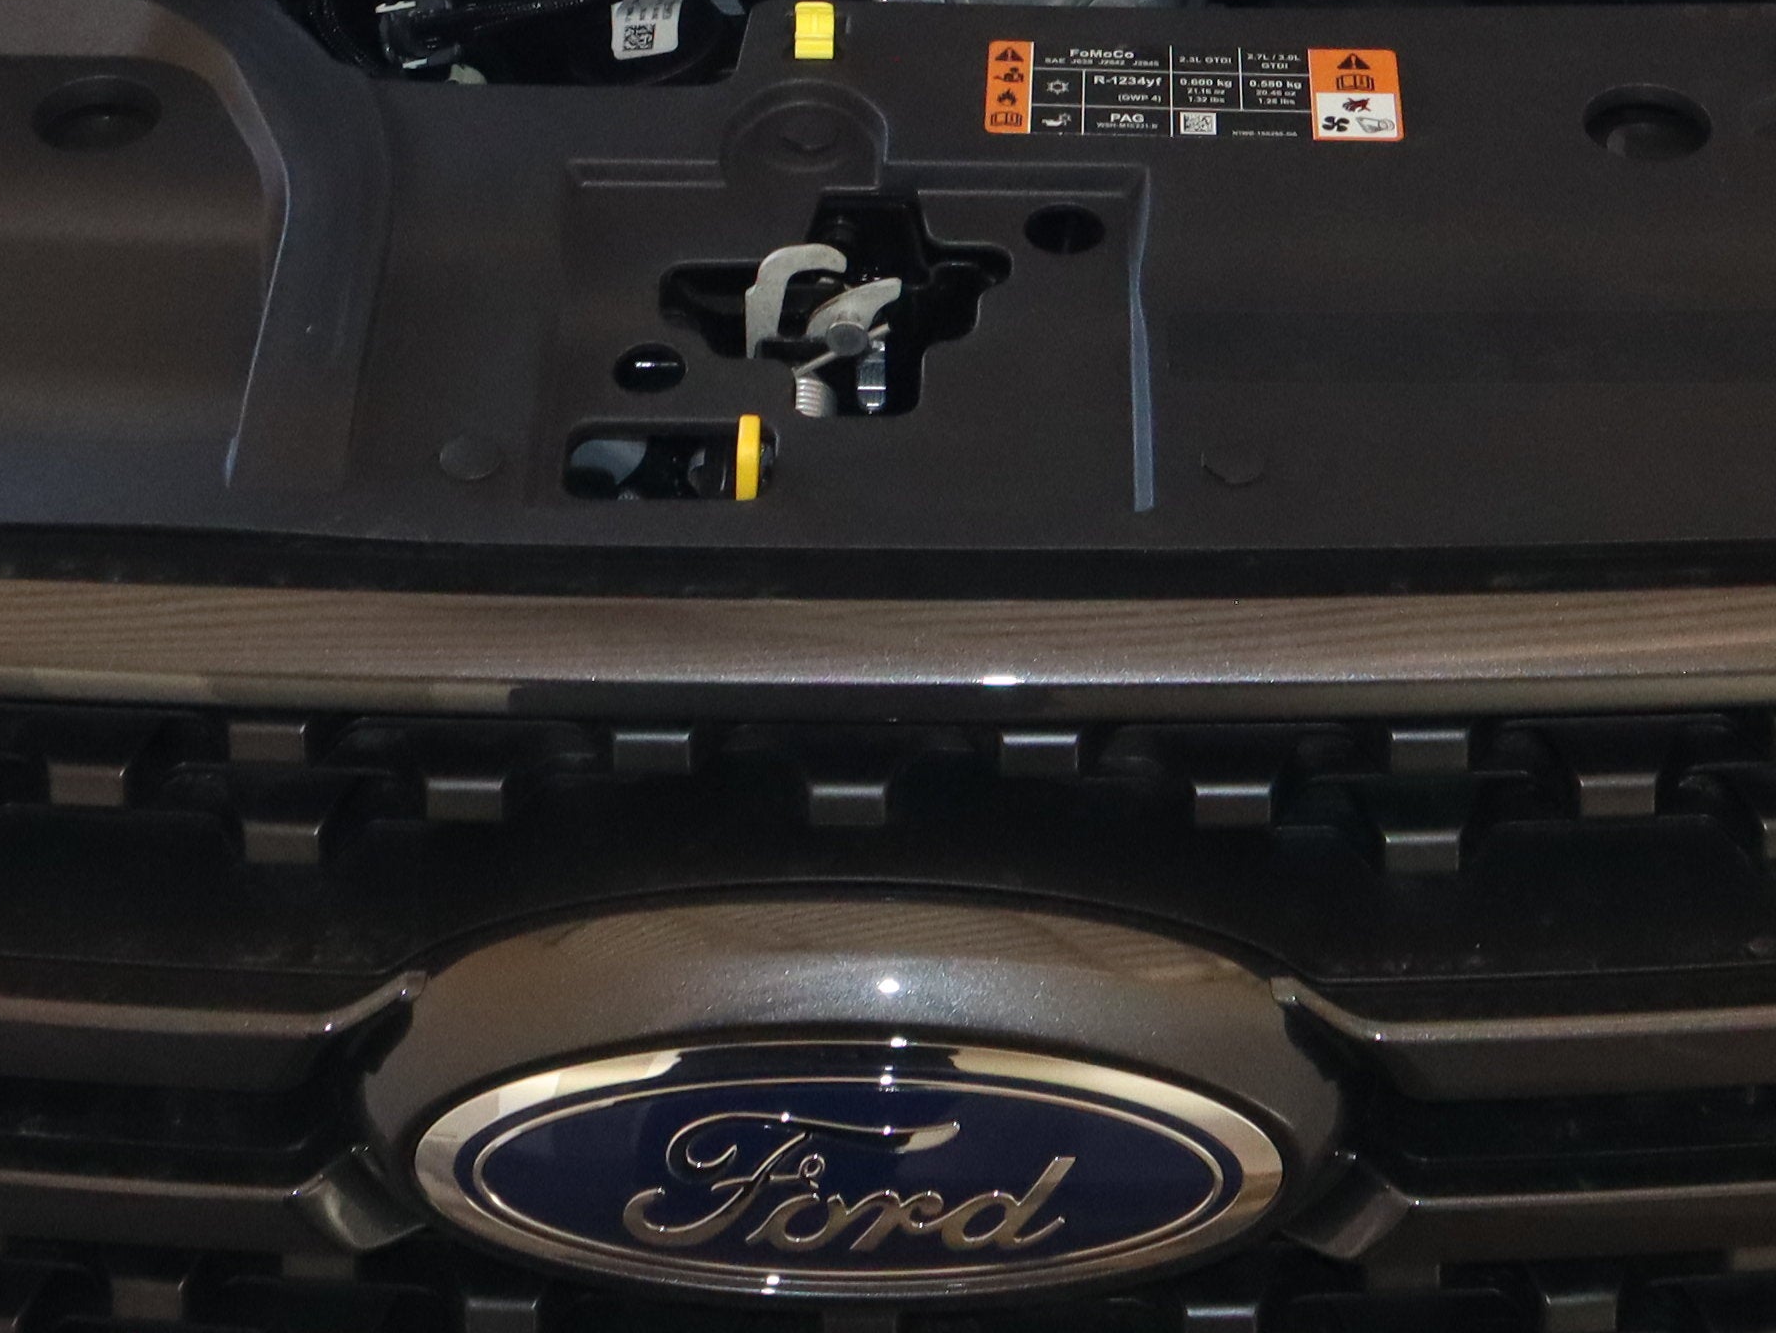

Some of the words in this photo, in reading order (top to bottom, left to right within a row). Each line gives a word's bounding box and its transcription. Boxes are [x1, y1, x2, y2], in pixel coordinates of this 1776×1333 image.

[1069, 48, 1135, 59] FoMoCo
[1178, 55, 1202, 64] 2.3L
[1204, 56, 1233, 64] GTDI
[1260, 61, 1289, 69] GTDI
[1093, 74, 1163, 88] R-1234yf
[1179, 78, 1214, 87] 0.600
[1216, 78, 1233, 89] kg
[1285, 79, 1303, 90] kg
[1117, 93, 1149, 103] (GWP
[1150, 94, 1162, 103] 4)
[1110, 112, 1146, 123] PAG
[620, 1110, 1068, 1255] Ford
